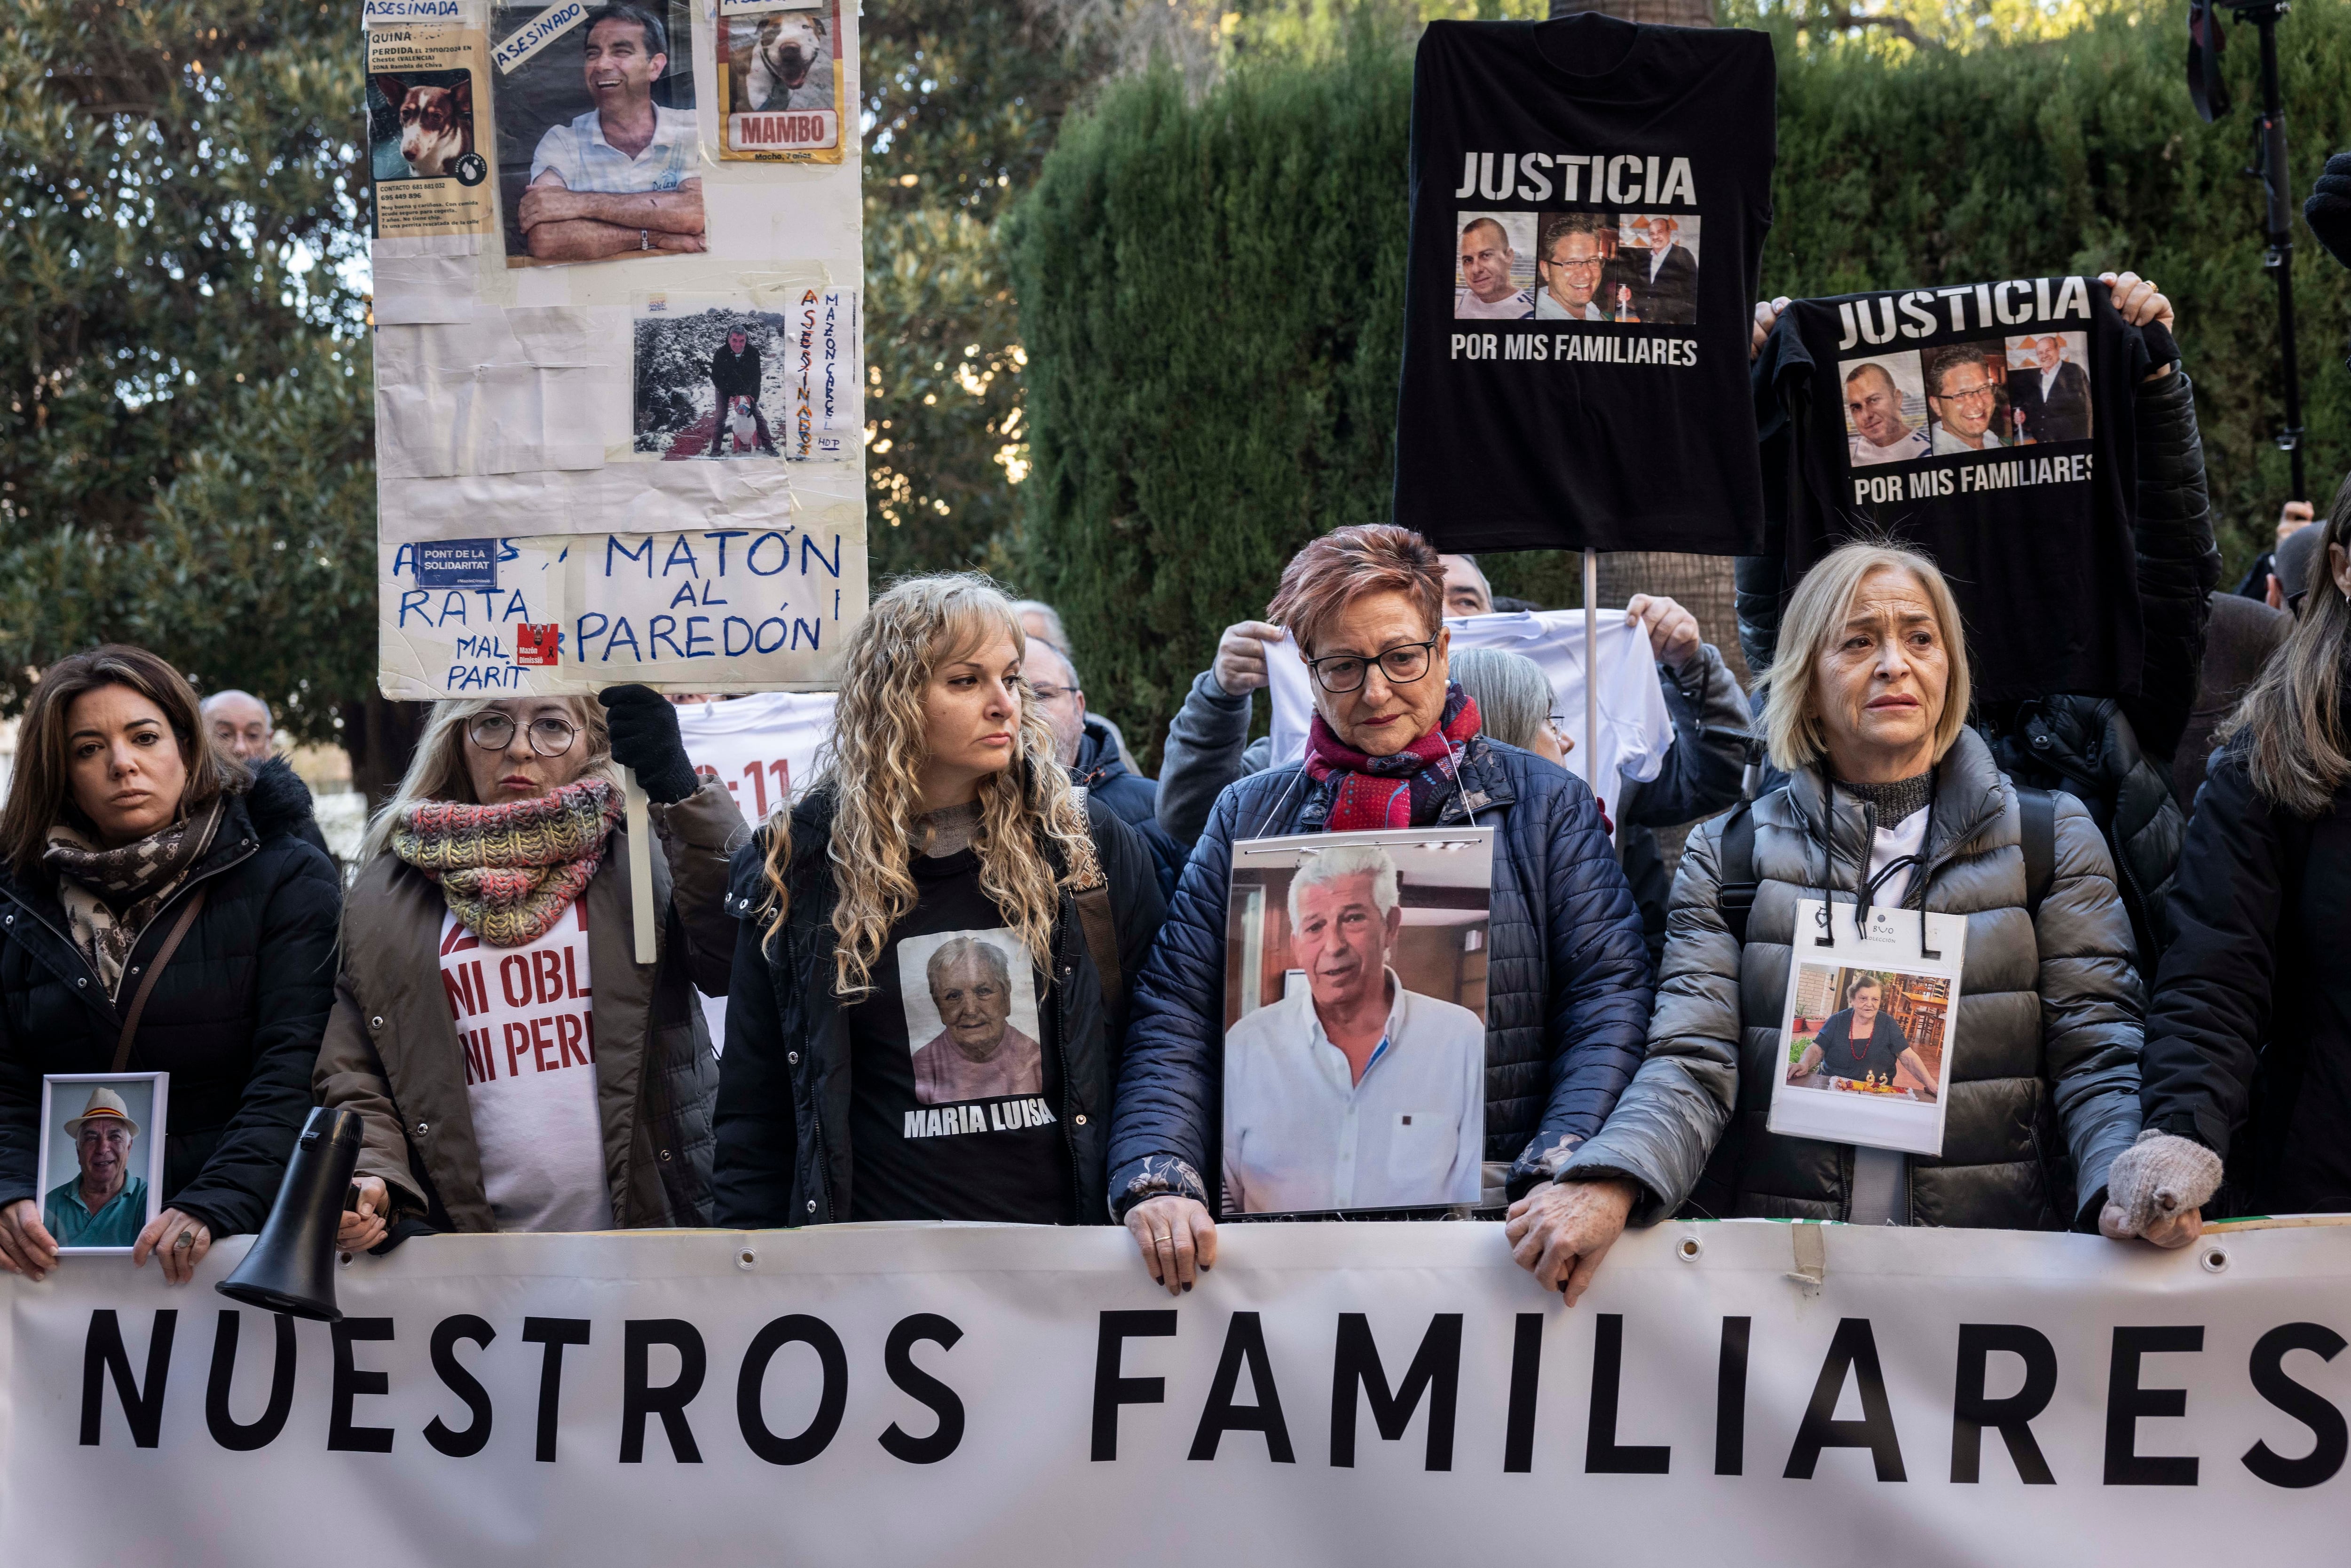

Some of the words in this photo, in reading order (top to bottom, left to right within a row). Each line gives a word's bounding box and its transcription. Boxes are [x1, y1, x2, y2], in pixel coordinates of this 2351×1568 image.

[372, 32, 412, 43] QUINA
[372, 47, 413, 55] PERDIDA
[742, 116, 824, 143] MAMBO
[1455, 152, 1697, 205] JUSTICIA
[1838, 276, 2091, 351] JUSTICIA
[1451, 333, 1497, 360] POR
[1504, 334, 1549, 361] MIS
[1554, 334, 1698, 366] FAMILIARES
[1854, 475, 1903, 505] POR
[1909, 468, 1955, 499] MIS
[424, 561, 490, 570] SOLIDARITAT
[605, 525, 840, 578] MATÓN
[399, 588, 529, 629] RATA
[670, 579, 728, 609] AL
[457, 635, 510, 659] MAL
[577, 602, 820, 662] PAREDÓN
[442, 960, 489, 1020] NI
[458, 1027, 496, 1086] NI
[904, 1105, 987, 1138] MARIA
[990, 1097, 1057, 1131] LUISA
[79, 1309, 965, 1466] NUESTROS
[1090, 1309, 2350, 1489] FAMILIARES
